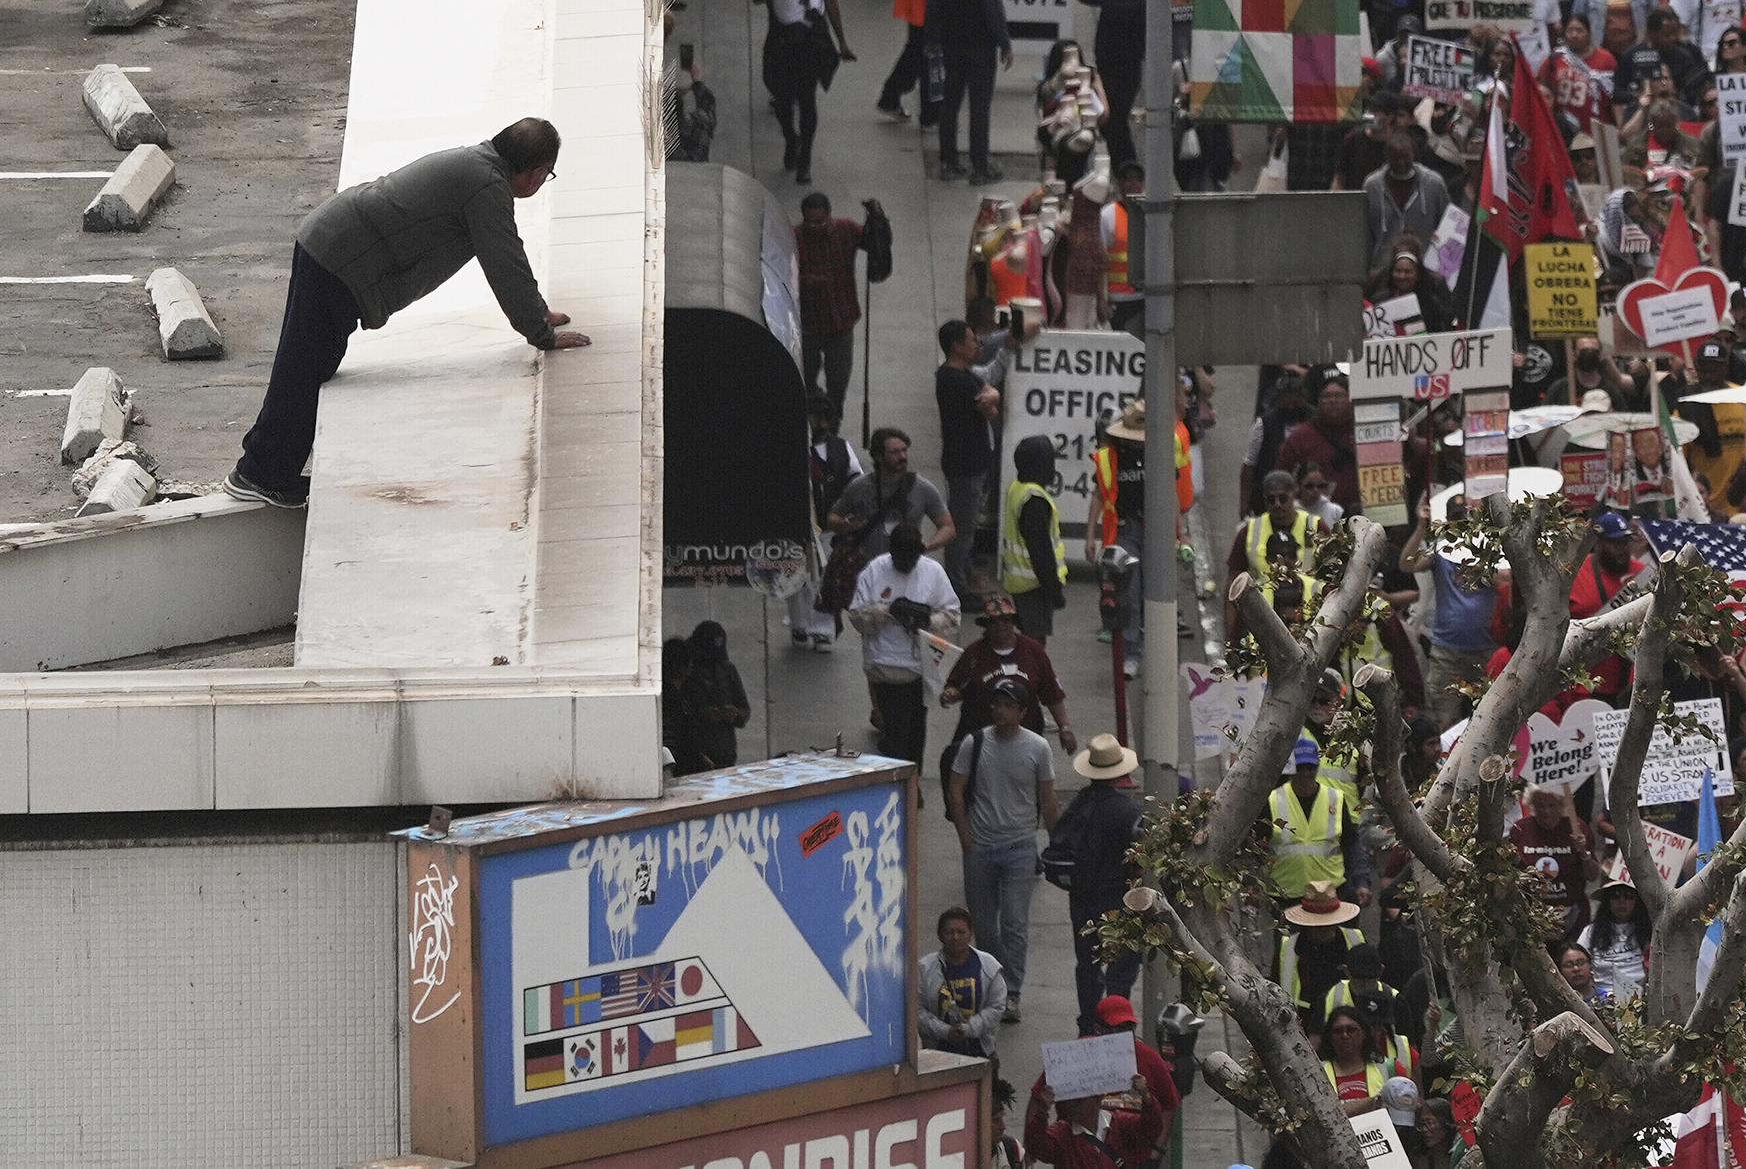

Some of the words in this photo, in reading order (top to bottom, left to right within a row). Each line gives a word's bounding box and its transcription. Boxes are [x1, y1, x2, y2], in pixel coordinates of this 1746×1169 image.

[1411, 38, 1453, 66] FREE
[1719, 77, 1736, 91] LA
[1551, 246, 1571, 258] LA
[1536, 262, 1587, 274] LUCHA
[1534, 276, 1592, 290] OBRERA
[1552, 292, 1578, 307] NO
[1547, 307, 1585, 320] TIENE
[1015, 349, 1145, 377] LEASING
[1365, 341, 1438, 379] HANDS
[1450, 334, 1494, 369] OFF
[1415, 373, 1450, 399] US
[1361, 469, 1401, 486] FREE
[1530, 738, 1558, 755] We
[1532, 743, 1594, 771] Belong
[1535, 760, 1582, 783] Here!
[1653, 771, 1668, 782] US
